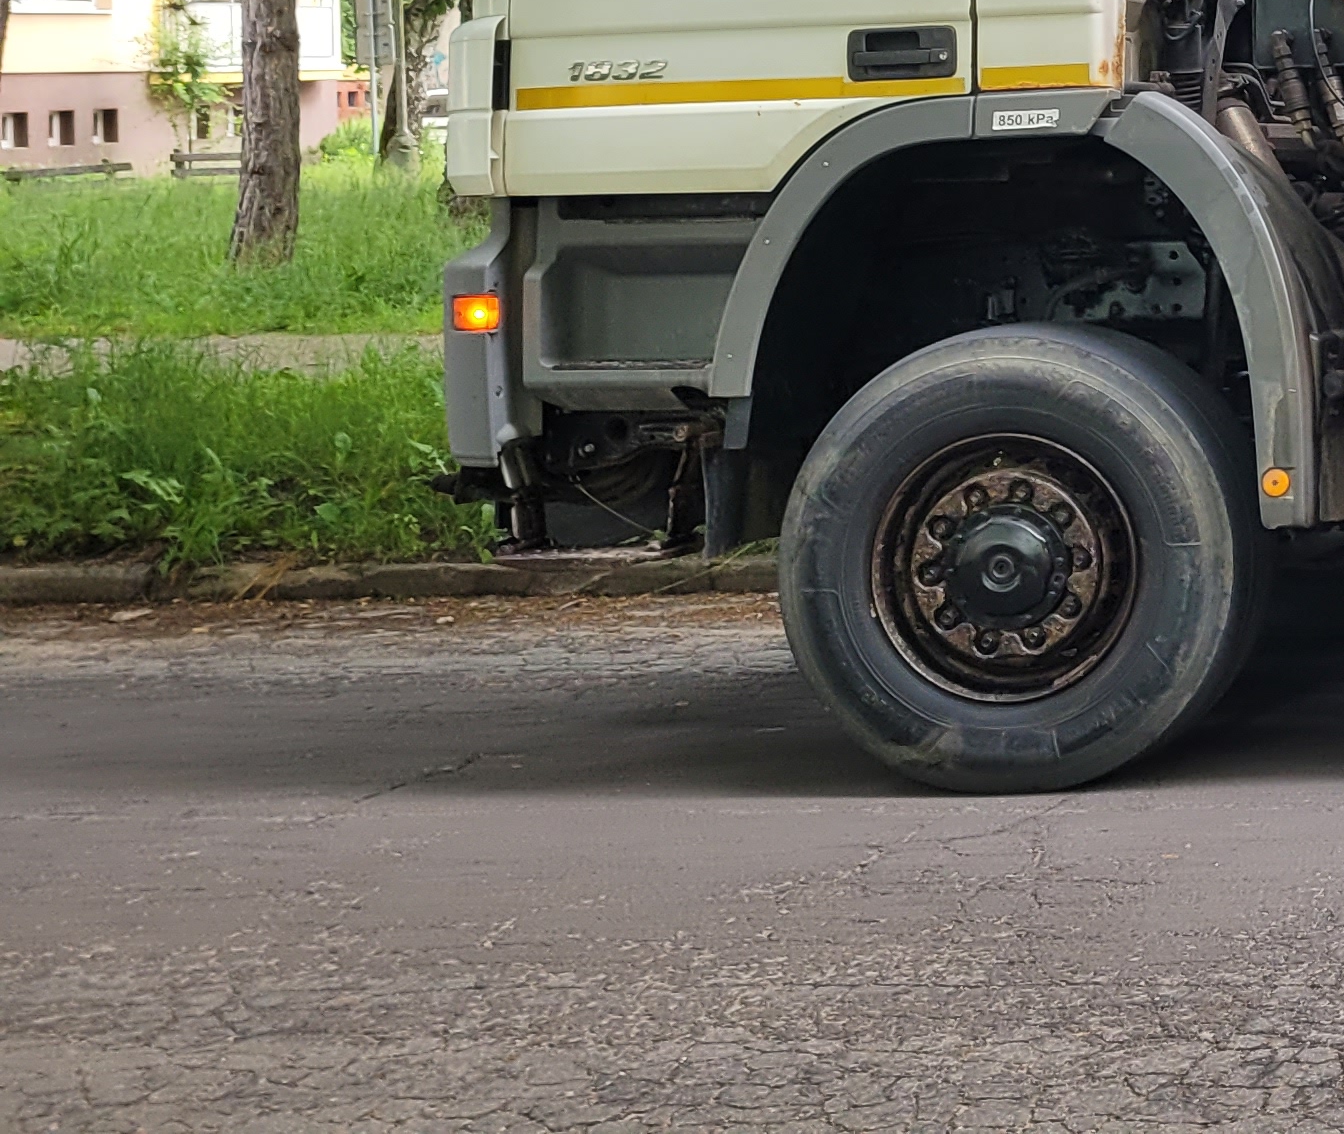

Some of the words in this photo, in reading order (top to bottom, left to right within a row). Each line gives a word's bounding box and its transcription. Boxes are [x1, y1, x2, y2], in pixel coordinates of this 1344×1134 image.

[568, 60, 667, 82] 1832
[998, 114, 1023, 126] 850
[1028, 113, 1054, 126] kPa
